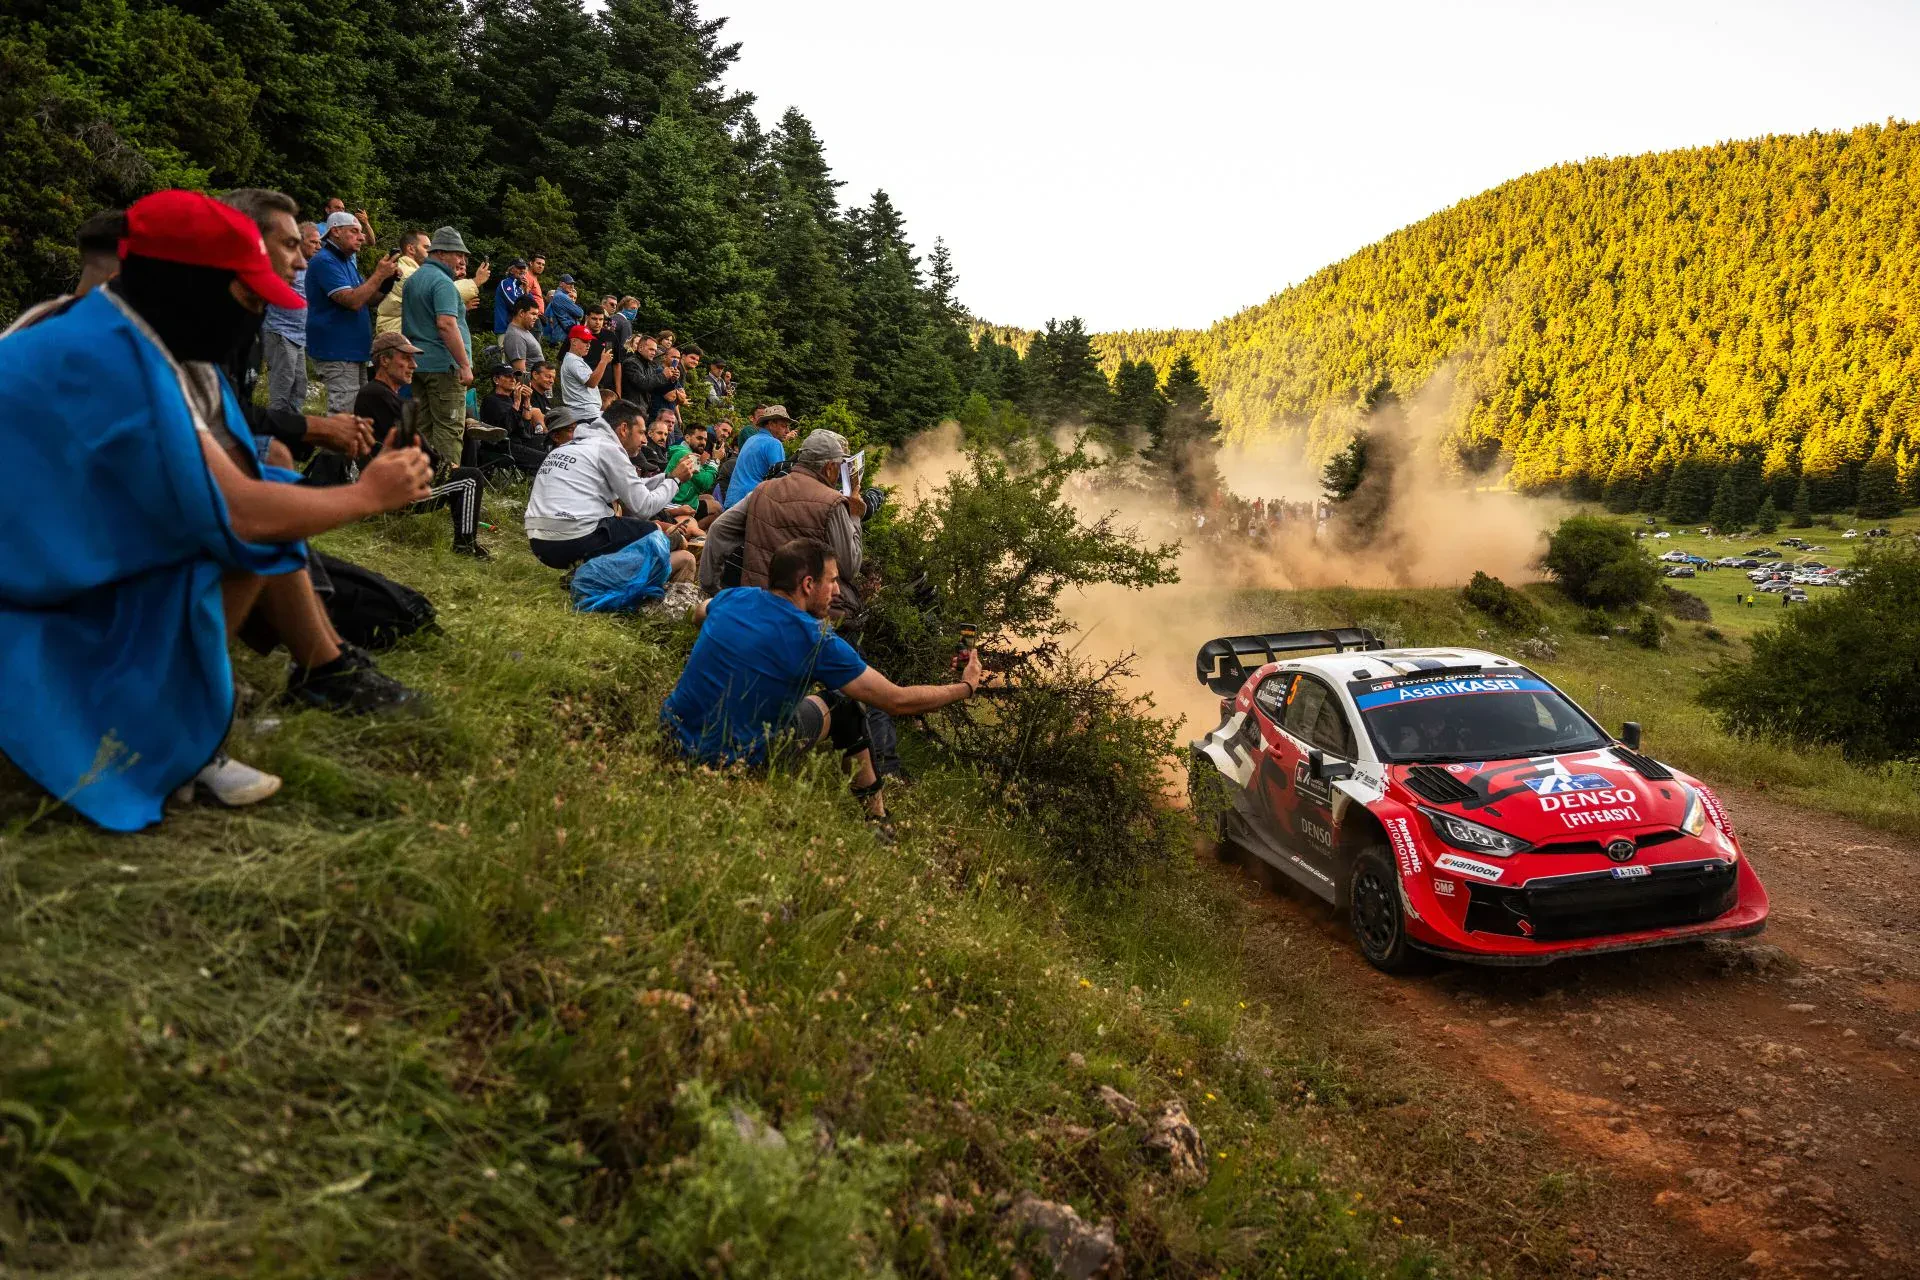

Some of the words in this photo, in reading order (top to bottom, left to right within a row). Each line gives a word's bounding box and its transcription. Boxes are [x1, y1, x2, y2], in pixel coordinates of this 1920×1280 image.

[1286, 674, 1303, 705] 5
[1371, 681, 1394, 691] GR
[1396, 677, 1443, 686] TOYOTA
[1539, 789, 1637, 812] DENSO
[1302, 818, 1331, 847] DENSO
[1395, 817, 1422, 873] Panasonic
[1385, 819, 1413, 877] AUTOMOTIVE
[1620, 867, 1644, 877] A-7657
[1434, 881, 1455, 894] OMP
